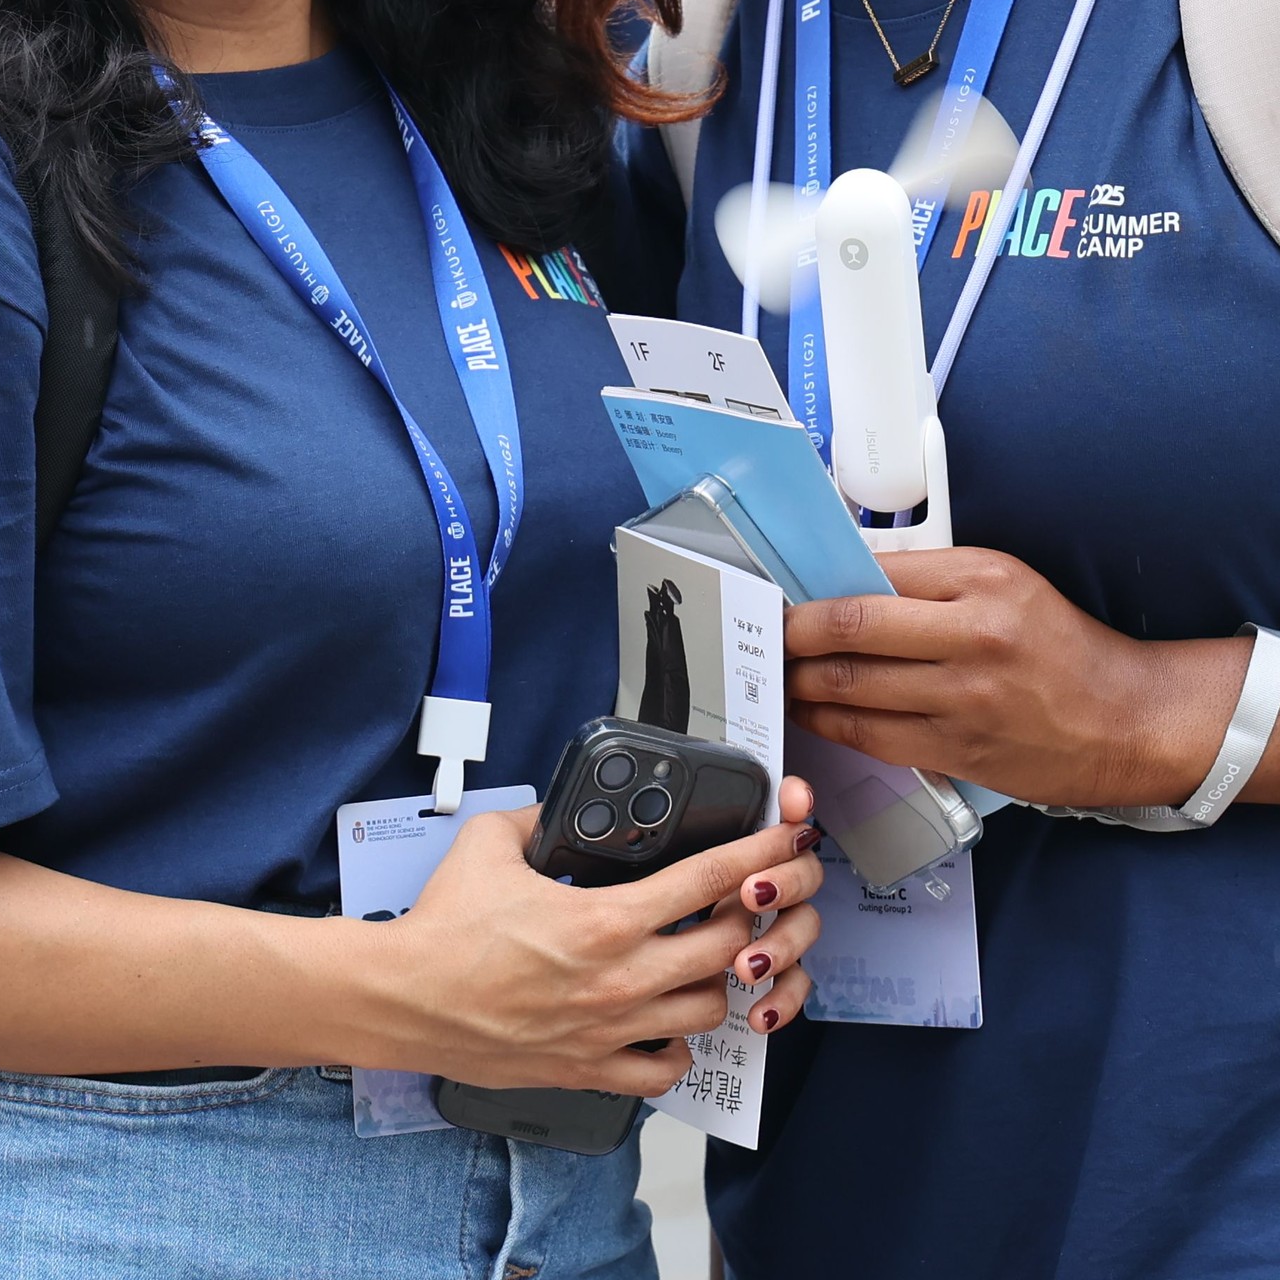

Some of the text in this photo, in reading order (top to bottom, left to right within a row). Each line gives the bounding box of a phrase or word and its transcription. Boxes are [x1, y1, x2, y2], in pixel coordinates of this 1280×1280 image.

[807, 85, 818, 178] HKUST(GZ)
[257, 200, 317, 288] HKUST(GZ)
[431, 204, 469, 291] HKUST(GZ)
[1076, 236, 1144, 259] CAMP
[1081, 211, 1180, 237] SUMMER
[330, 309, 372, 367] PLACE
[457, 317, 499, 371] PLACE
[630, 341, 726, 372] 1F 2F
[803, 333, 818, 429] HKUST(GZ)
[449, 555, 474, 618] PLACE
[737, 640, 765, 659] vanke
[1193, 763, 1241, 821] eel Good
[858, 903, 913, 915] Outing Group 2
[898, 888, 907, 900] C
[674, 1061, 744, 1115] 龍的
